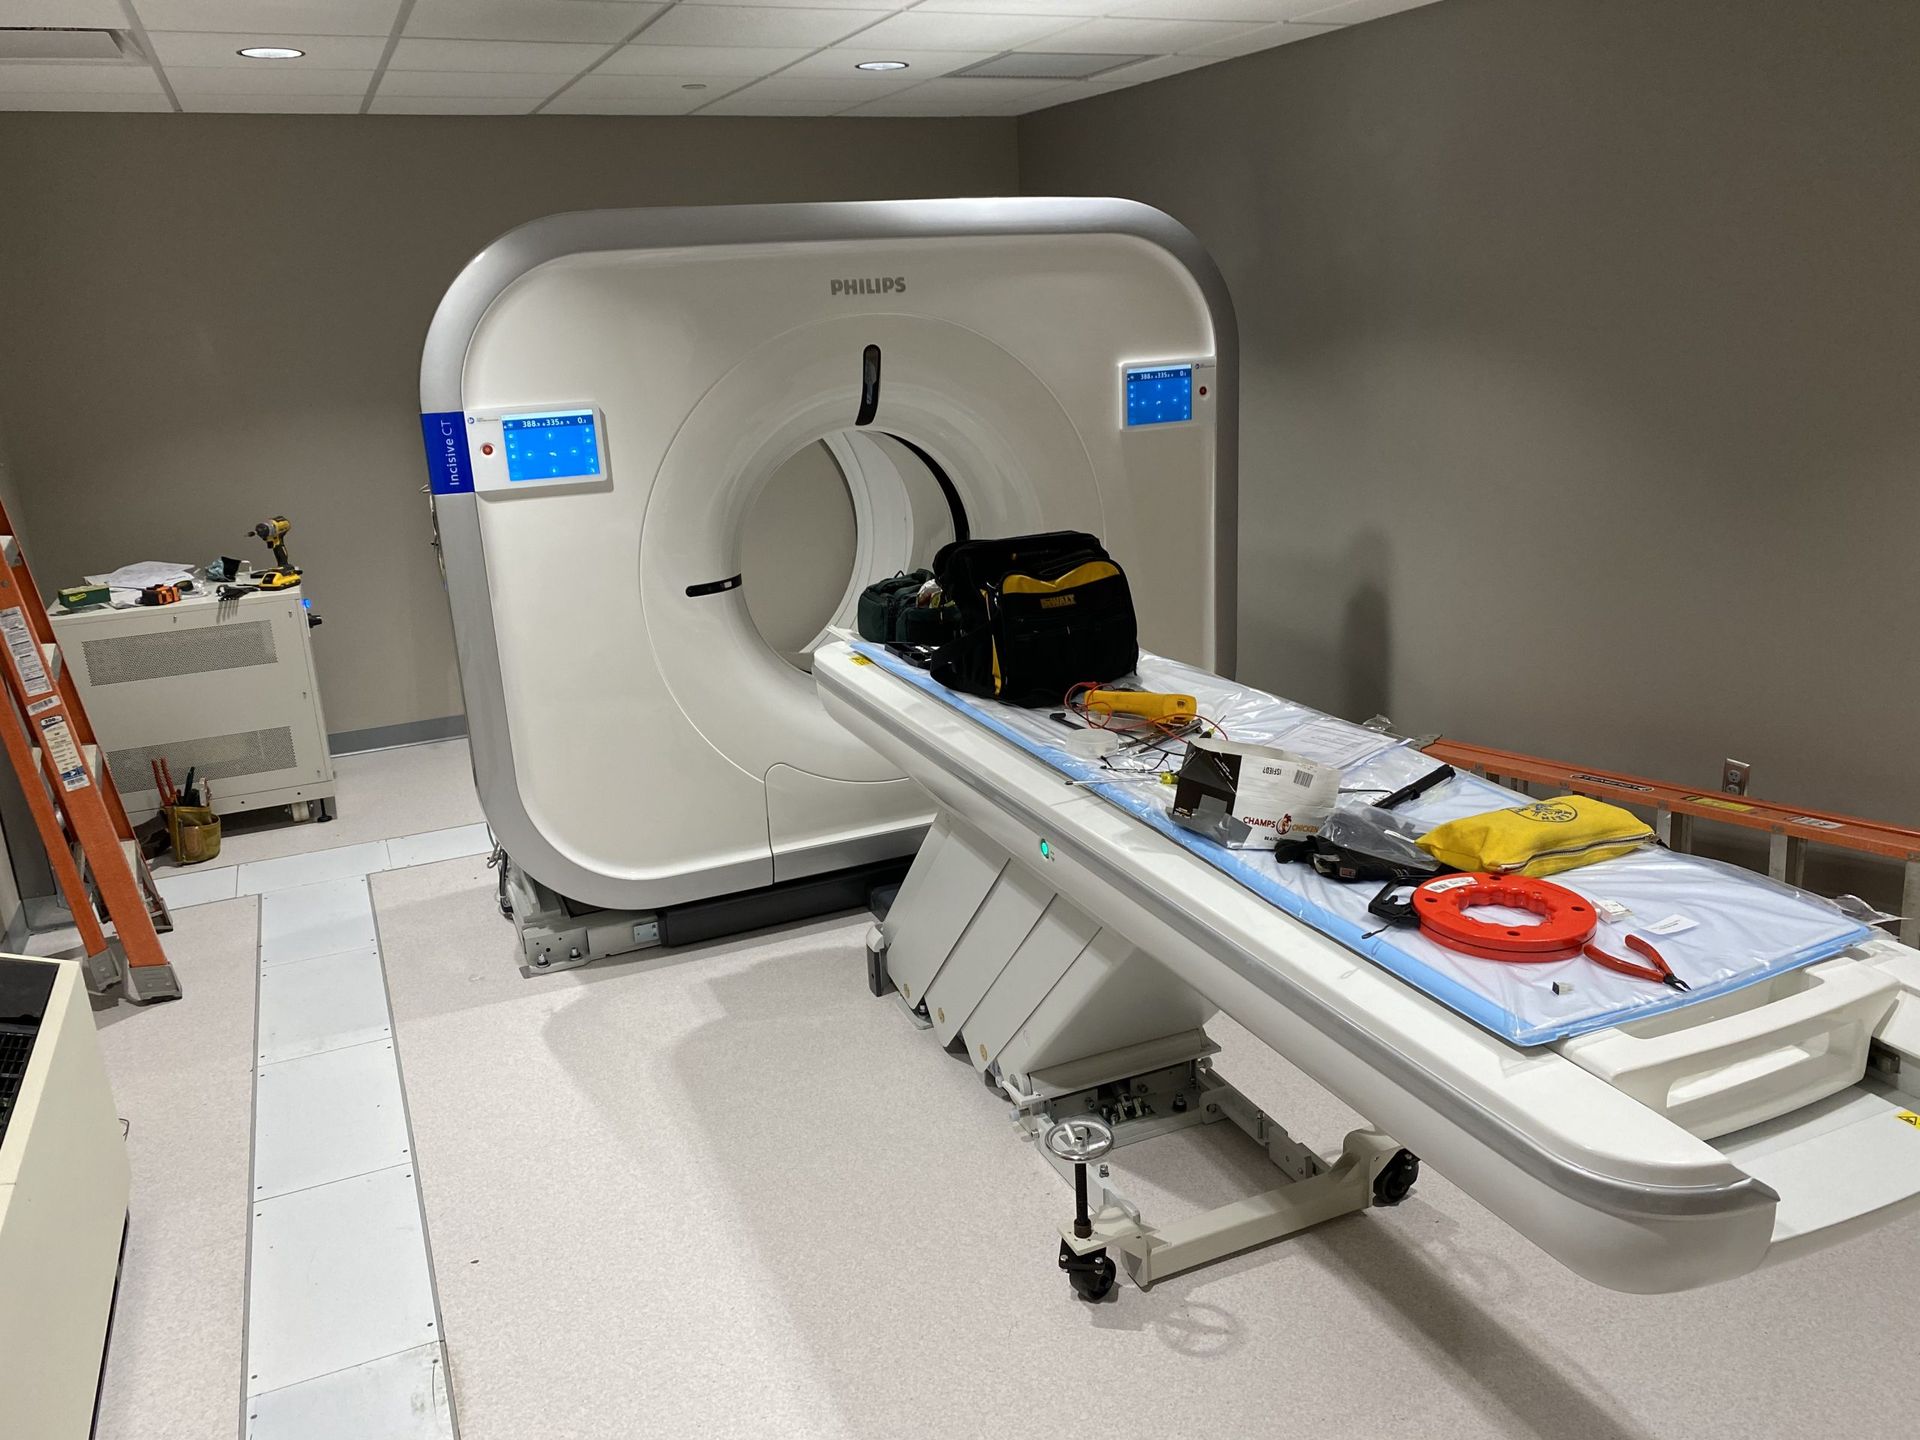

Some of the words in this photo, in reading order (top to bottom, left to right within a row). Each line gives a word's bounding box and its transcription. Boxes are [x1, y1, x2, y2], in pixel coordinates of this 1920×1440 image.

[830, 277, 906, 295] PHILIPS
[440, 420, 453, 436] CT
[445, 438, 460, 486] Incisive
[1242, 816, 1277, 829] CHAMPS
[1291, 823, 1320, 833] CHICKEN
